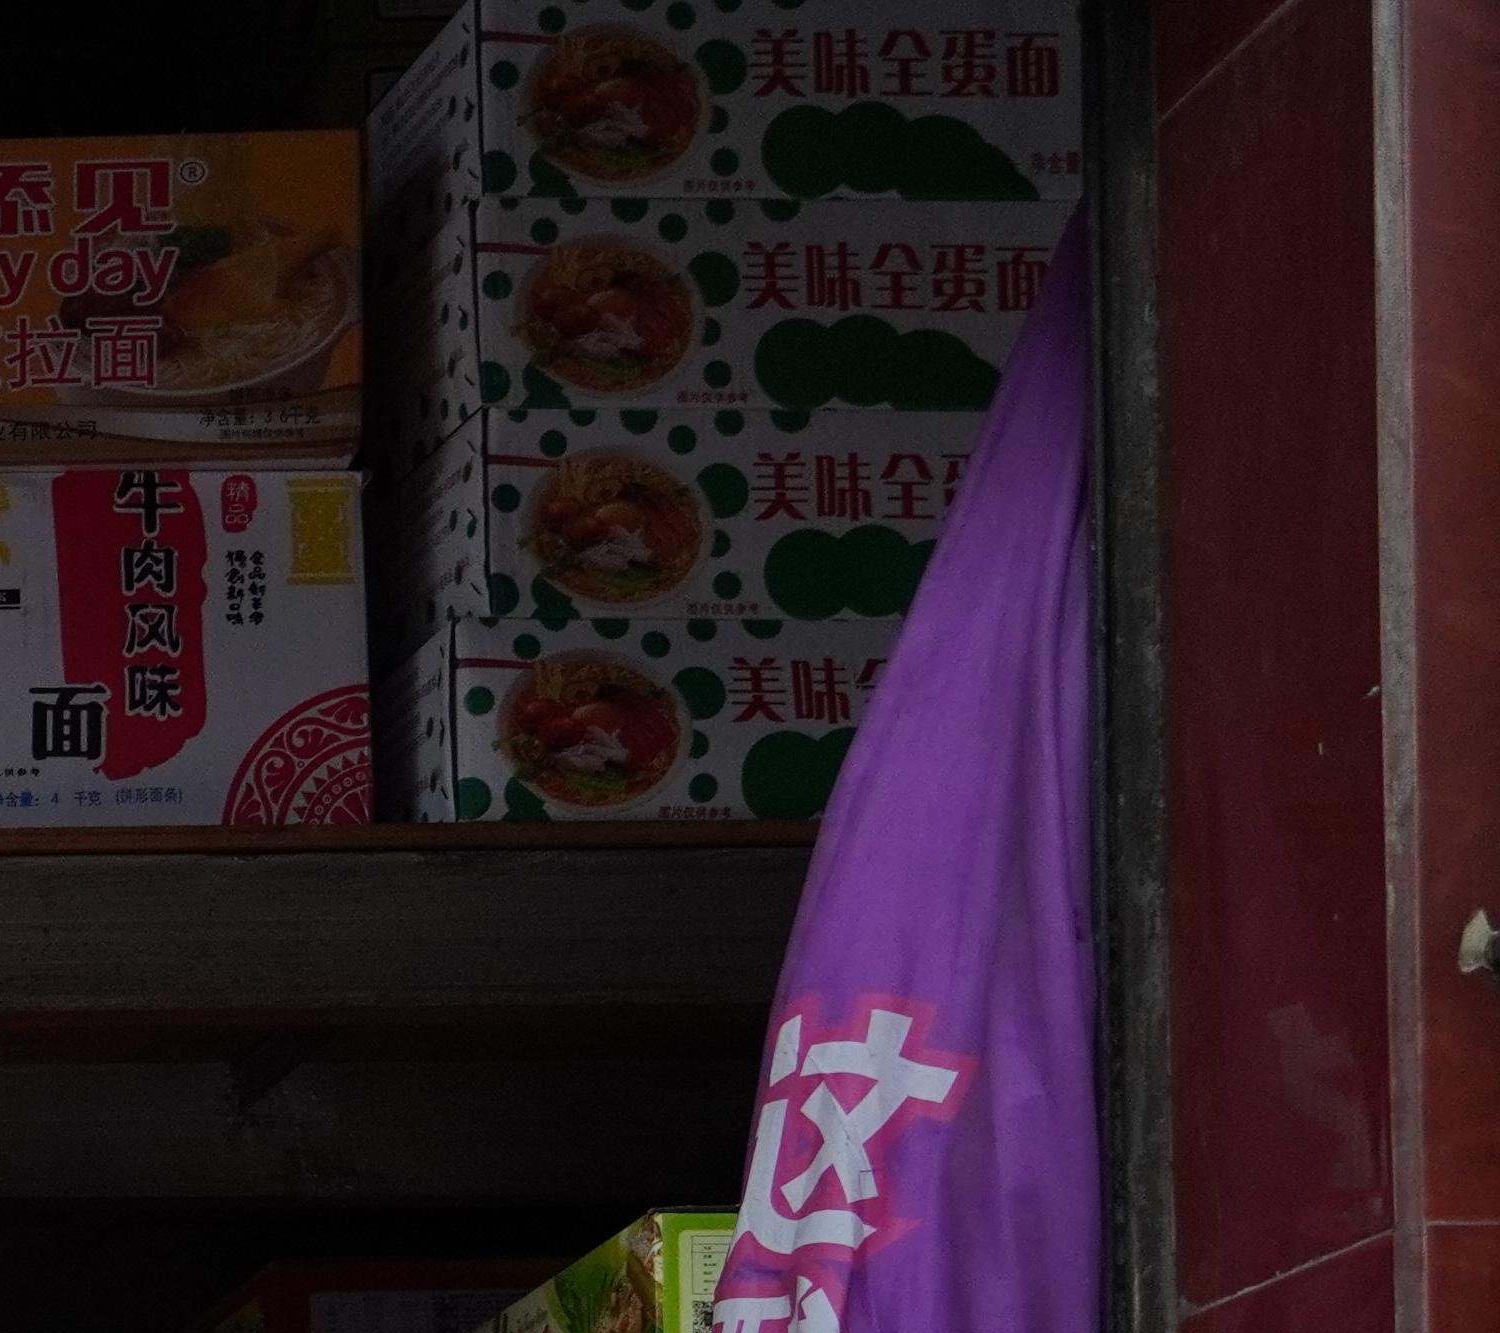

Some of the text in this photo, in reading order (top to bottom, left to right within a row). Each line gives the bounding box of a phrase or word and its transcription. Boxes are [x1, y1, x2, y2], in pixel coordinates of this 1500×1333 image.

[750, 30, 1061, 97] 美味全蛋面
[49, 245, 179, 306] day
[752, 452, 974, 522] 美味全
[30, 683, 108, 762] 面
